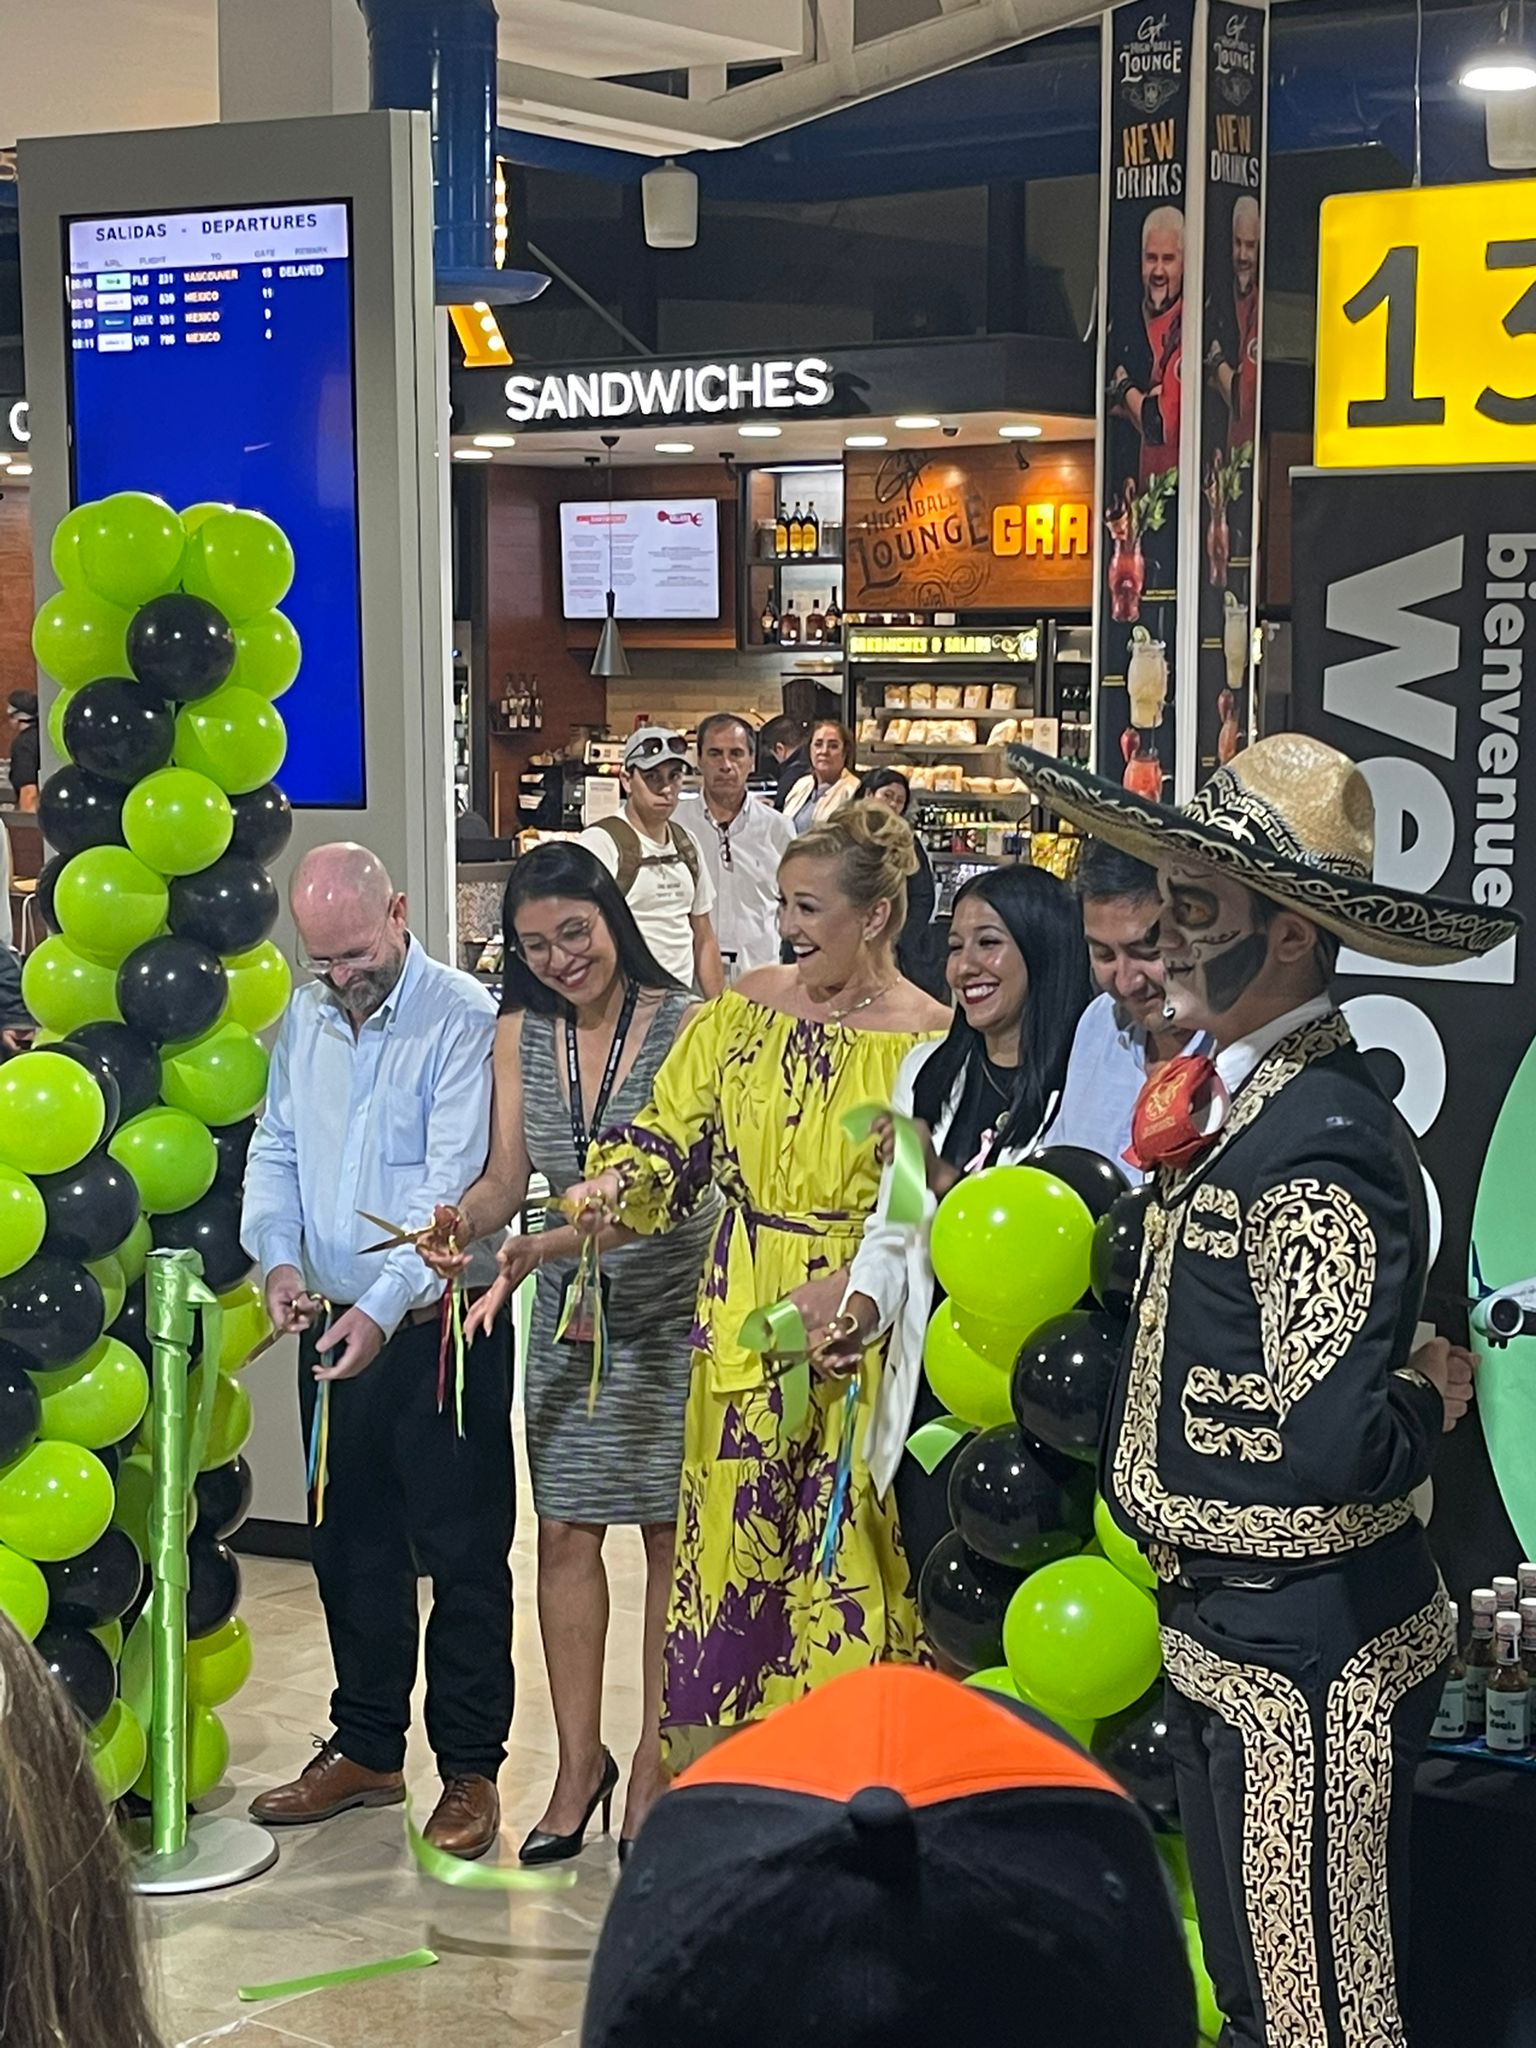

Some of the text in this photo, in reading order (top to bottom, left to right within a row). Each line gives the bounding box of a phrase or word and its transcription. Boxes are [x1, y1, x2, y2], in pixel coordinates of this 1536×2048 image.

[1119, 47, 1182, 83] LOUNGE
[1213, 42, 1255, 75] LOUNGE
[1123, 118, 1174, 167] NEW
[1216, 114, 1250, 153] NEW
[1116, 163, 1182, 200] DRINKS
[1210, 150, 1259, 187] DRINKS
[96, 224, 167, 242] SALIDAS
[202, 213, 317, 235] DEPARTURES
[184, 268, 239, 283] VANCOUVER
[279, 264, 325, 278] DELAYED
[184, 290, 220, 303] MEXICO
[1342, 239, 1536, 428] 13
[505, 358, 831, 422] SANDWICHES
[864, 493, 958, 535] HIGH BALL
[993, 503, 1089, 557] GRA
[849, 493, 989, 597] LOUNGE
[1472, 533, 1536, 908] bienvenue
